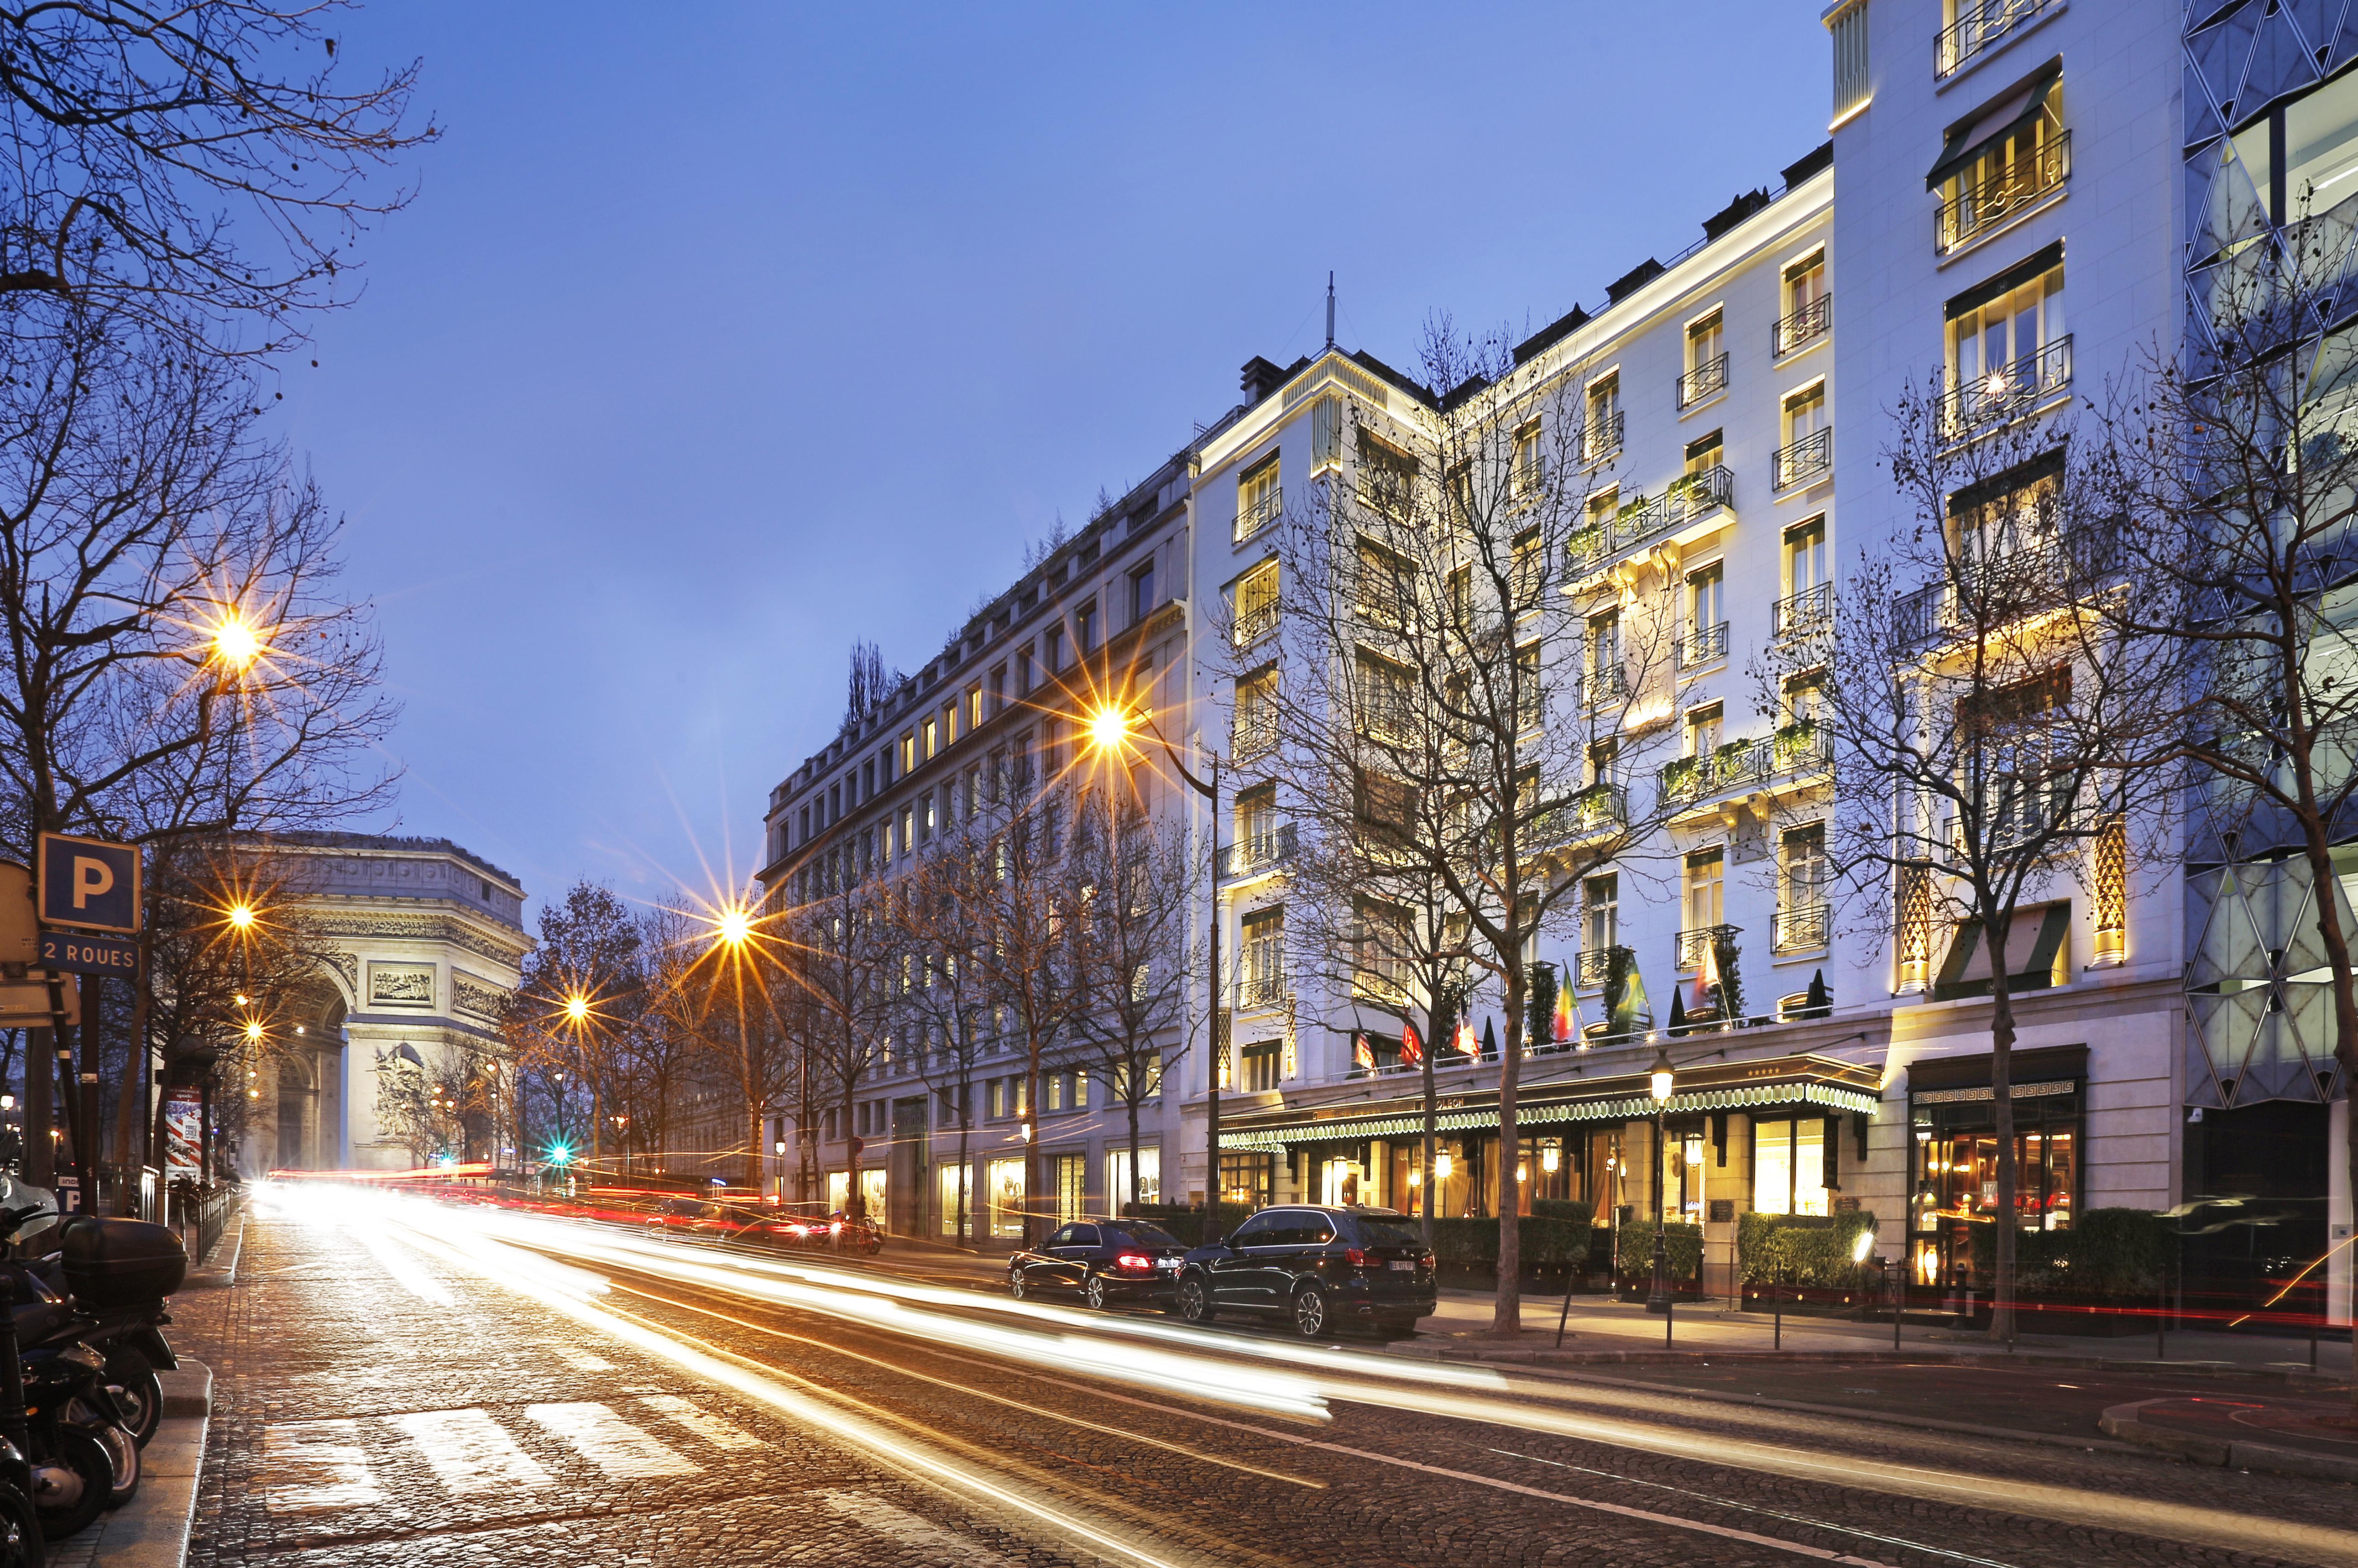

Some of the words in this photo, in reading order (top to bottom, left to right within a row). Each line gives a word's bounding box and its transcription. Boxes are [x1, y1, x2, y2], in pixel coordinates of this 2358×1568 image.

[73, 856, 114, 909] P
[44, 942, 56, 958] 2
[67, 945, 134, 967] ROUES
[1420, 1097, 1464, 1111] NOLEON
[67, 1191, 80, 1212] P
